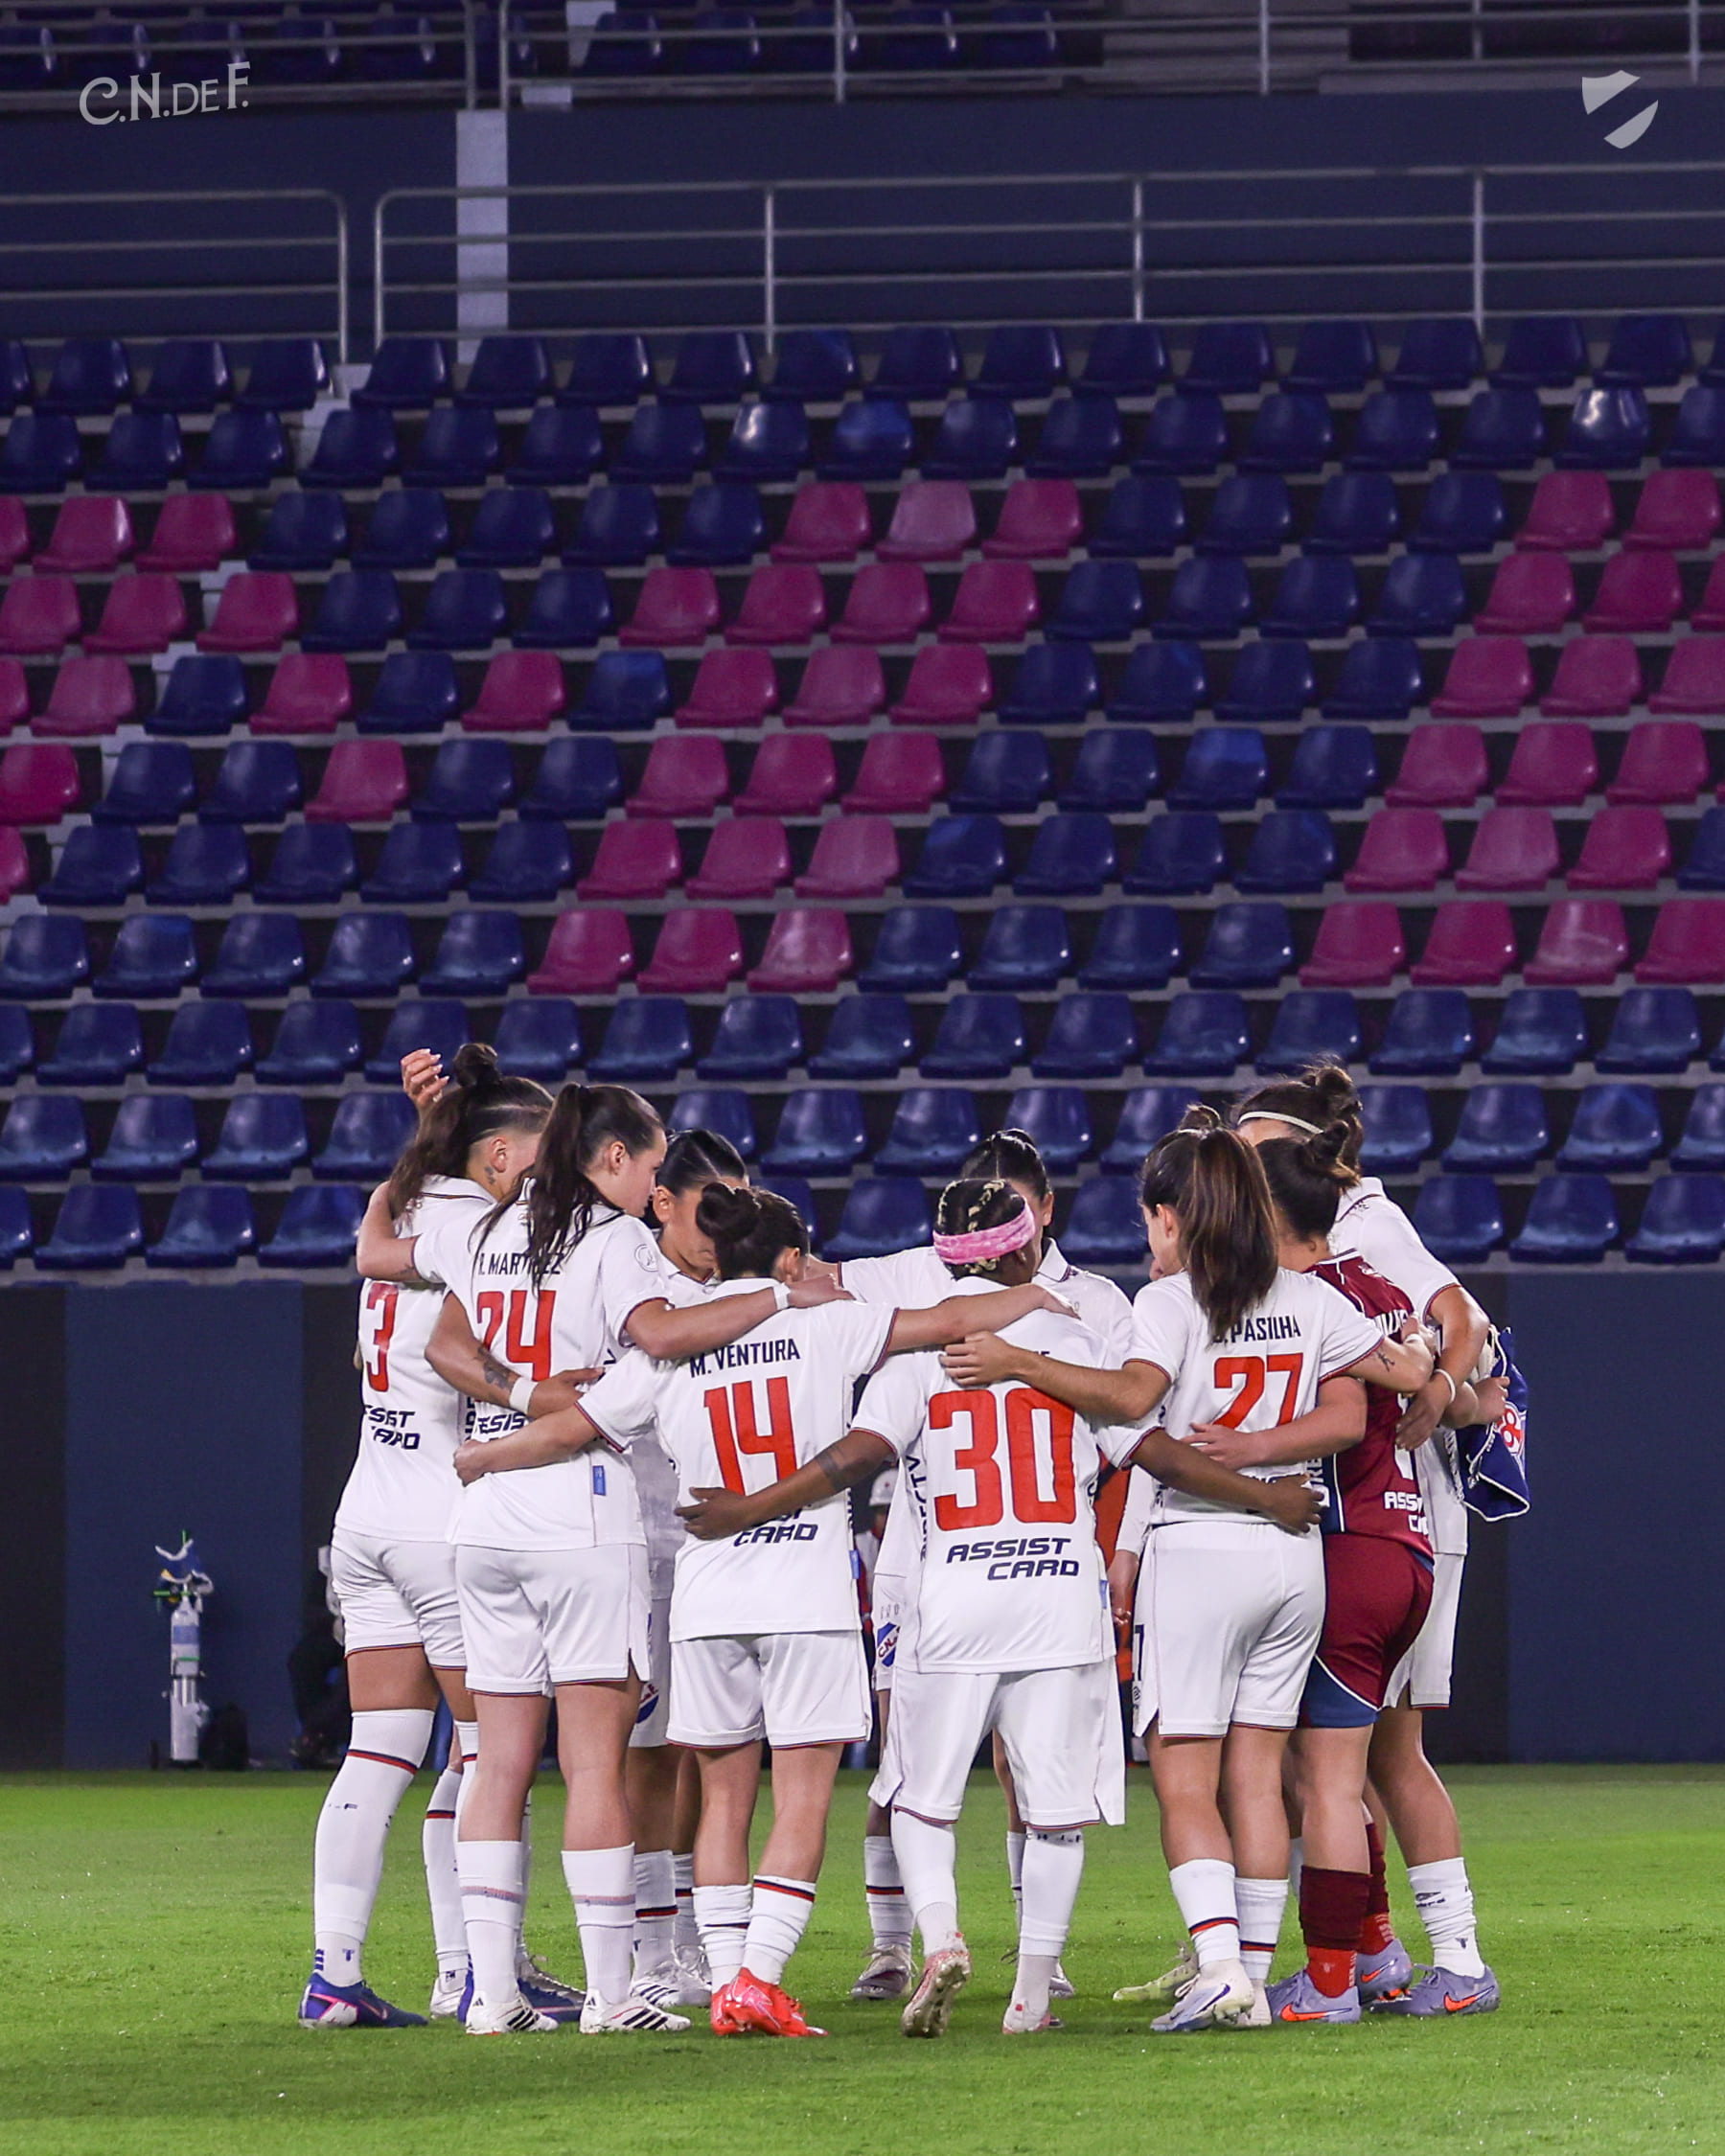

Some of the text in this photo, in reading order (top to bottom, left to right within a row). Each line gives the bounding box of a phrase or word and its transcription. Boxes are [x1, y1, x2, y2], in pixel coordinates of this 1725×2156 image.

[476, 1290, 557, 1382] 24
[689, 1338, 801, 1378] M. VENTURA
[1213, 1352, 1304, 1431] 27
[703, 1375, 798, 1496] 14
[928, 1387, 1077, 1532] 30
[945, 1537, 1071, 1565] ASSIST
[987, 1559, 1080, 1581] CARD
